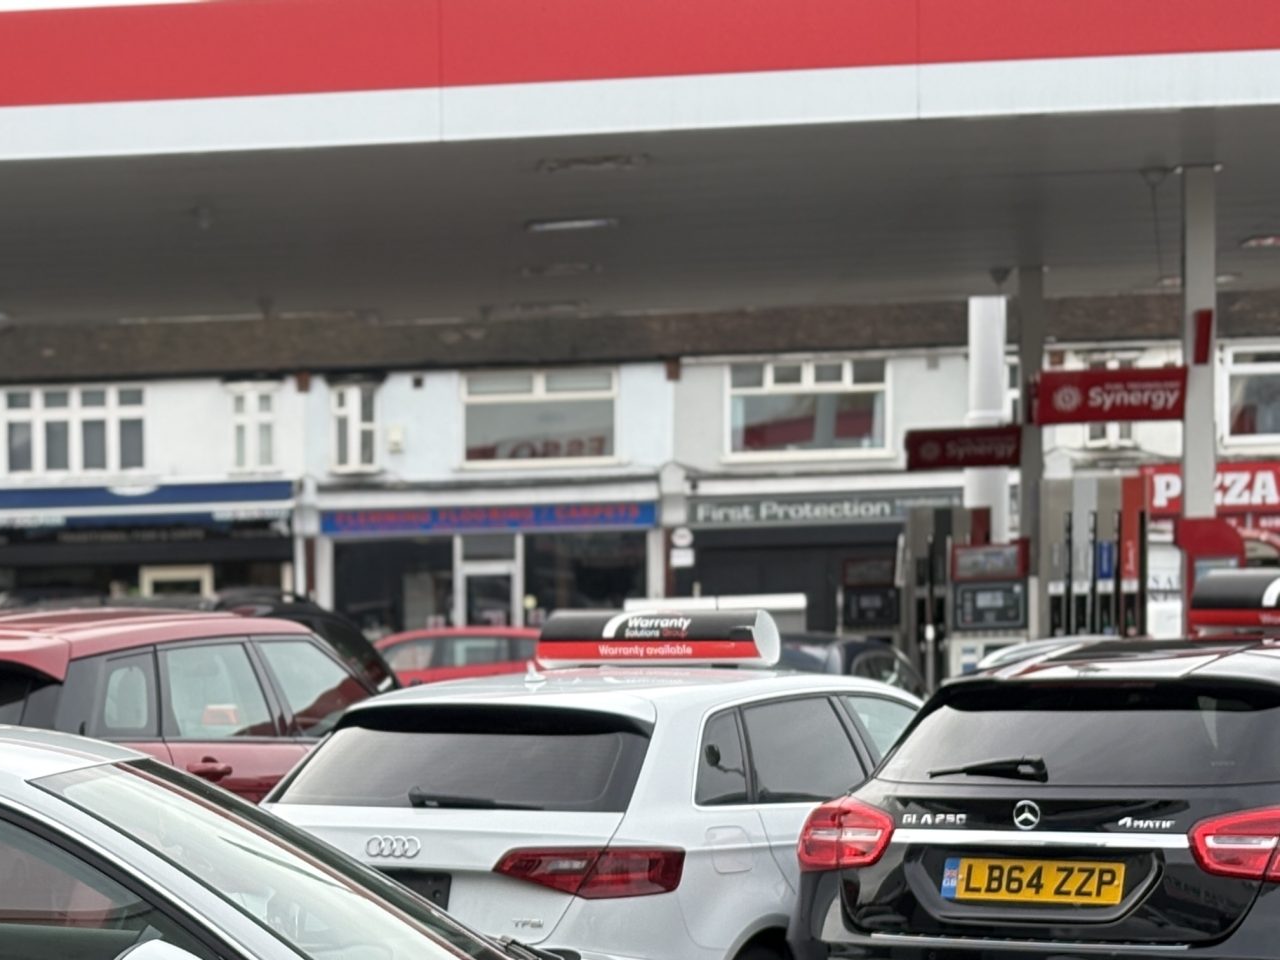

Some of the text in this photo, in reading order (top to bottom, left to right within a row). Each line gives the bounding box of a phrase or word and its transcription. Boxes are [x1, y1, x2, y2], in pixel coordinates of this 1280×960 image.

[1088, 385, 1181, 412] Synergy
[944, 440, 1017, 461] Synergy
[696, 502, 755, 522] First
[759, 500, 891, 520] Protection
[624, 628, 660, 639] Solutions
[627, 616, 692, 631] Warranty
[598, 643, 693, 656] Warranty available
[964, 863, 1117, 898] LB64 ZZP
